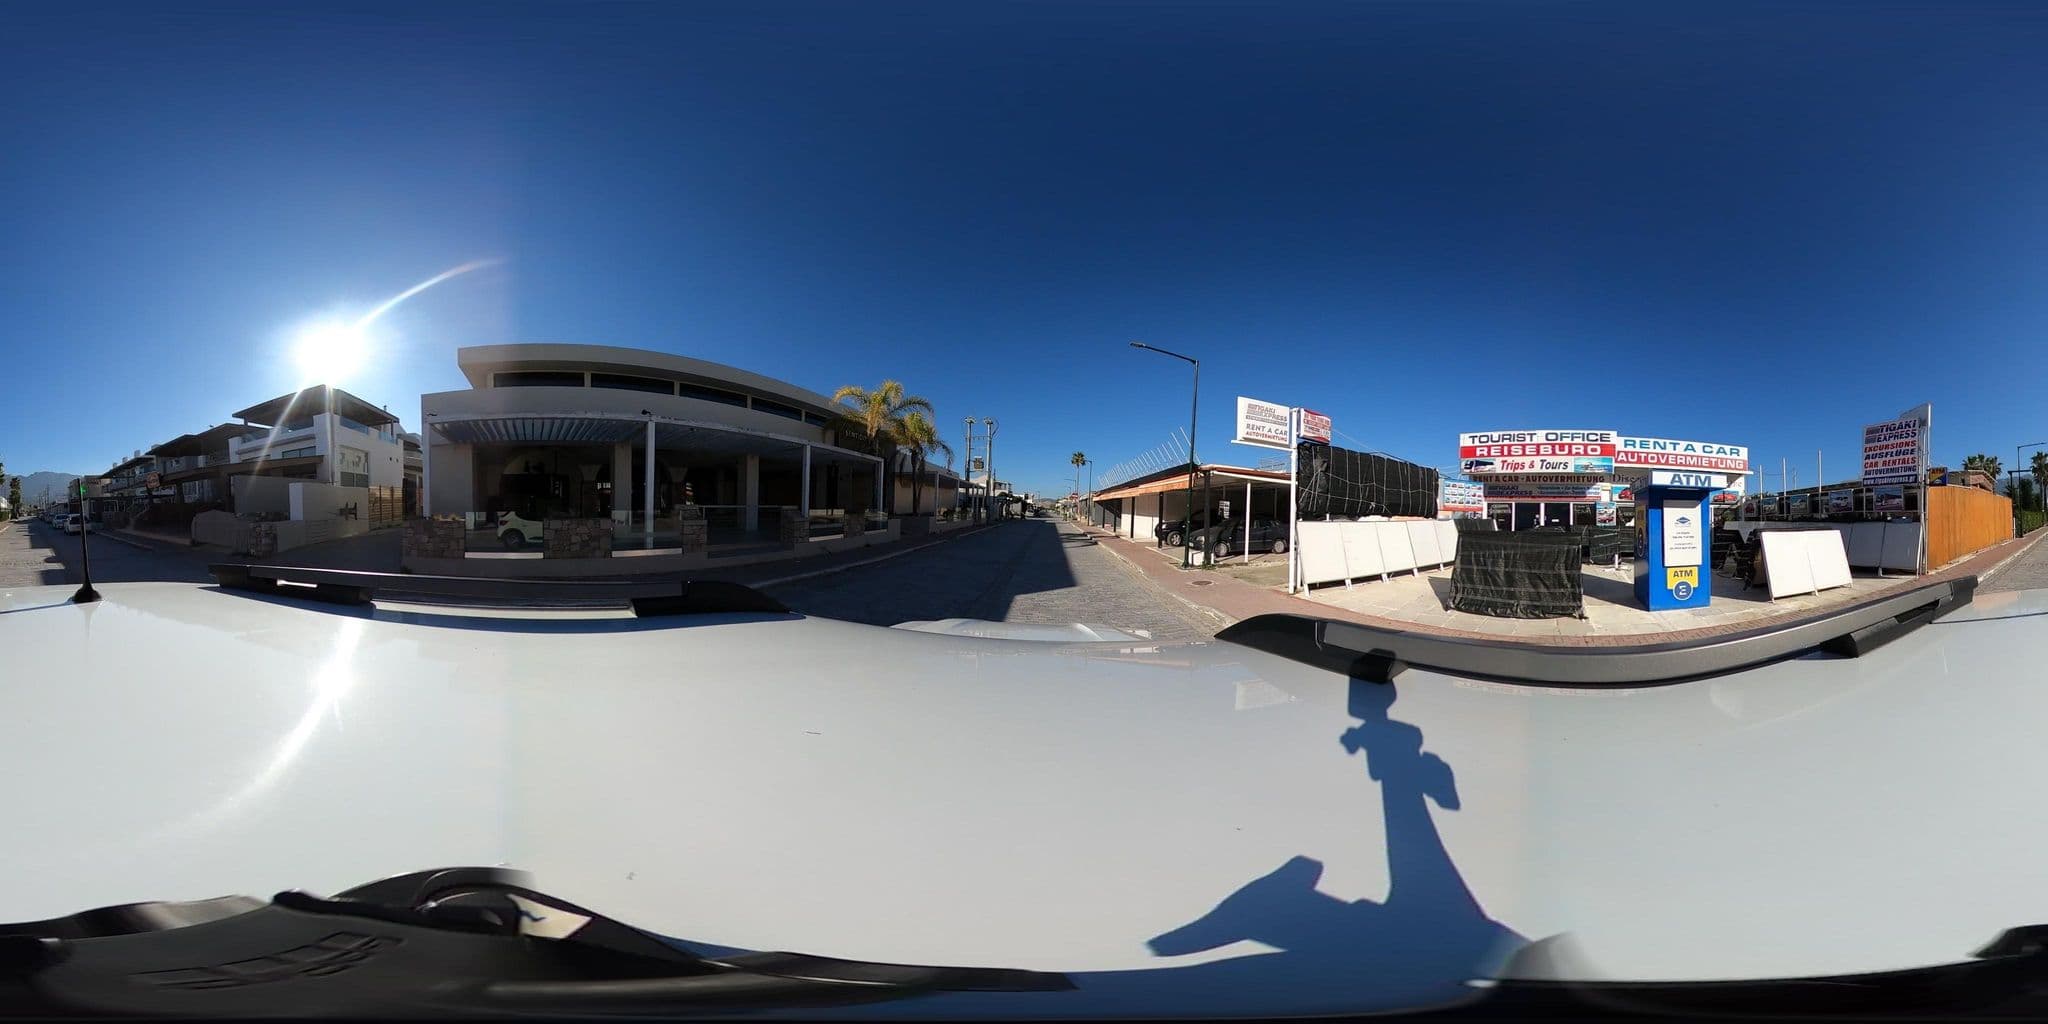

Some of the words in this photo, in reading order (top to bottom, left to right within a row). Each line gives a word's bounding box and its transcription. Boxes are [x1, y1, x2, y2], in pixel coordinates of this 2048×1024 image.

[1246, 423, 1266, 432] RENT
[1274, 428, 1288, 436] CAR
[1879, 419, 1917, 433] TIGAKI
[1469, 432, 1537, 444] TOURIST
[1545, 432, 1611, 442] OFFICE
[1877, 429, 1917, 442] EXPRESS
[1624, 439, 1681, 451] RENT
[1684, 443, 1697, 453] A
[1702, 445, 1740, 457] CAR
[1864, 440, 1917, 453] EXCURSIONS
[1500, 460, 1525, 472] Trips
[1528, 461, 1535, 469] &
[1540, 459, 1569, 470] Tours
[1617, 452, 1744, 469] AUTOVERMIETUNG
[1864, 461, 1879, 469] CAR
[1882, 457, 1917, 467] RENTALS
[1864, 465, 1917, 476] AUTOVERMIETUNG
[1472, 475, 1494, 483] RENT
[1495, 475, 1500, 483] A
[1503, 475, 1520, 483] CAR
[1525, 475, 1605, 483] AUTOVERMIETUNG
[1670, 473, 1712, 487] ATM
[1673, 569, 1693, 578] ATM
